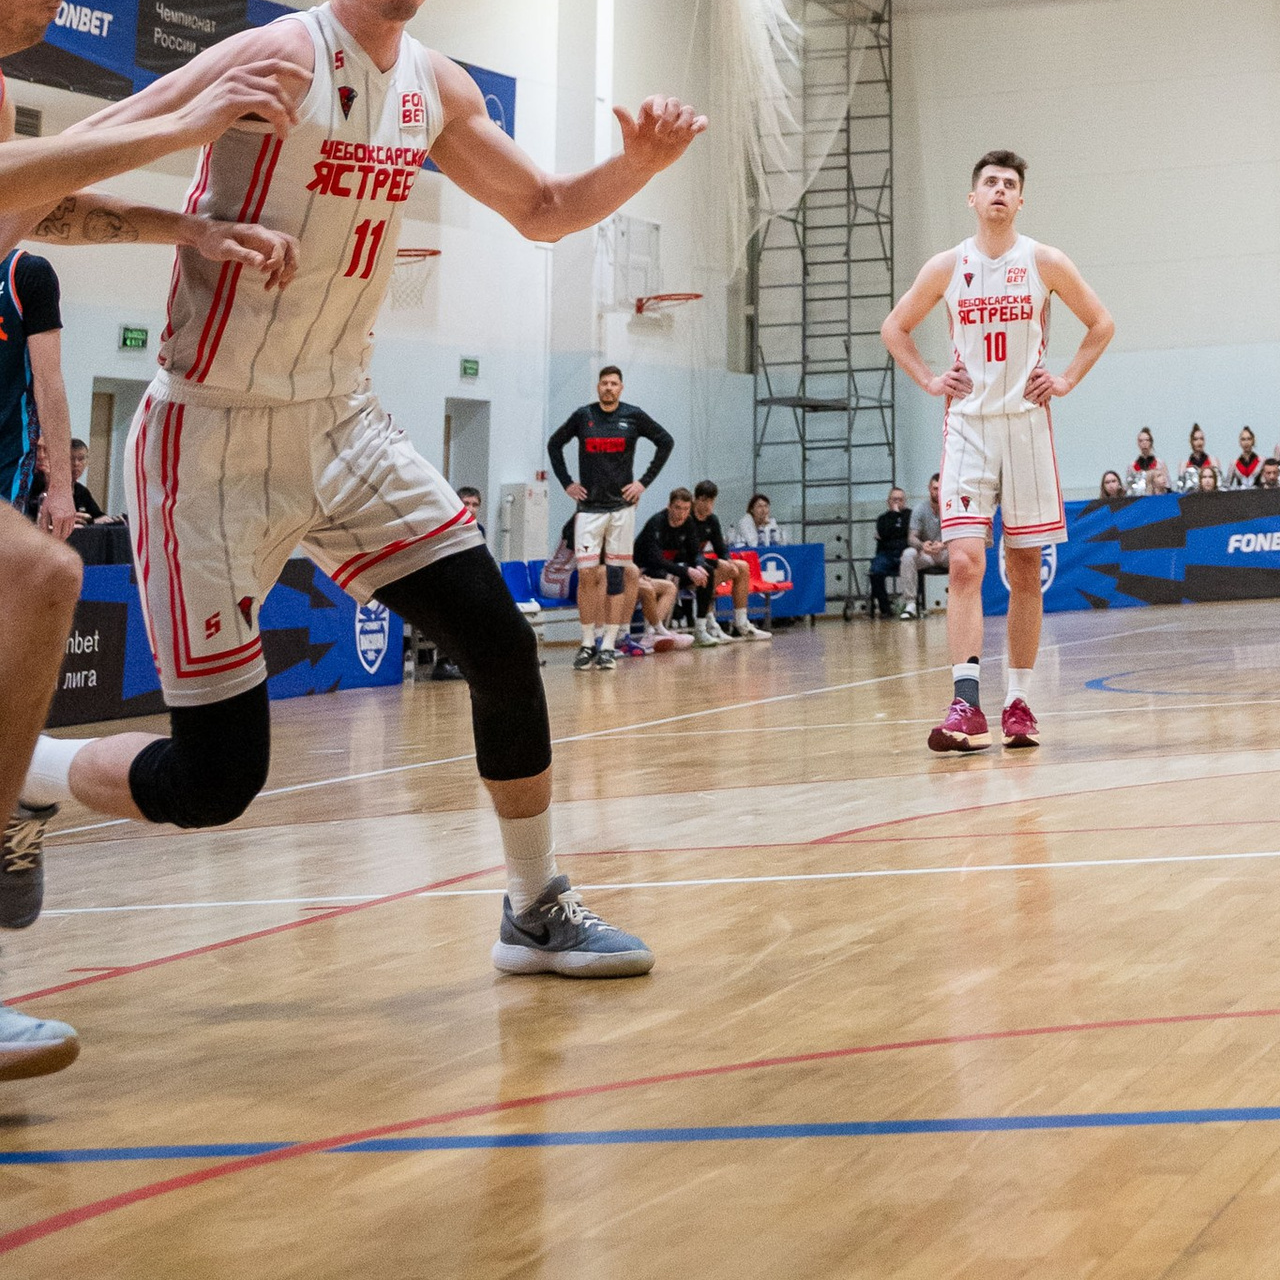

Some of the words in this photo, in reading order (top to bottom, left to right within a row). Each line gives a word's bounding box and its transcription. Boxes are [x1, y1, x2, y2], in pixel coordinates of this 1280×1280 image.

[55, 0, 113, 38] ONBET
[155, 1, 217, 34] Чемпионат
[154, 27, 196, 54] России
[320, 139, 428, 167] ЧЕБОКСАРСКИ
[306, 160, 415, 202] ЯСТРЕБ
[343, 219, 386, 280] 11
[1006, 275, 1025, 283] BET
[1007, 267, 1027, 275] FON
[957, 305, 1033, 325] ЯСТРЕБЫ
[958, 295, 1031, 309] ЧЕБОКСАРСКИЕ
[984, 331, 1006, 363] 10
[63, 669, 97, 689] лига
